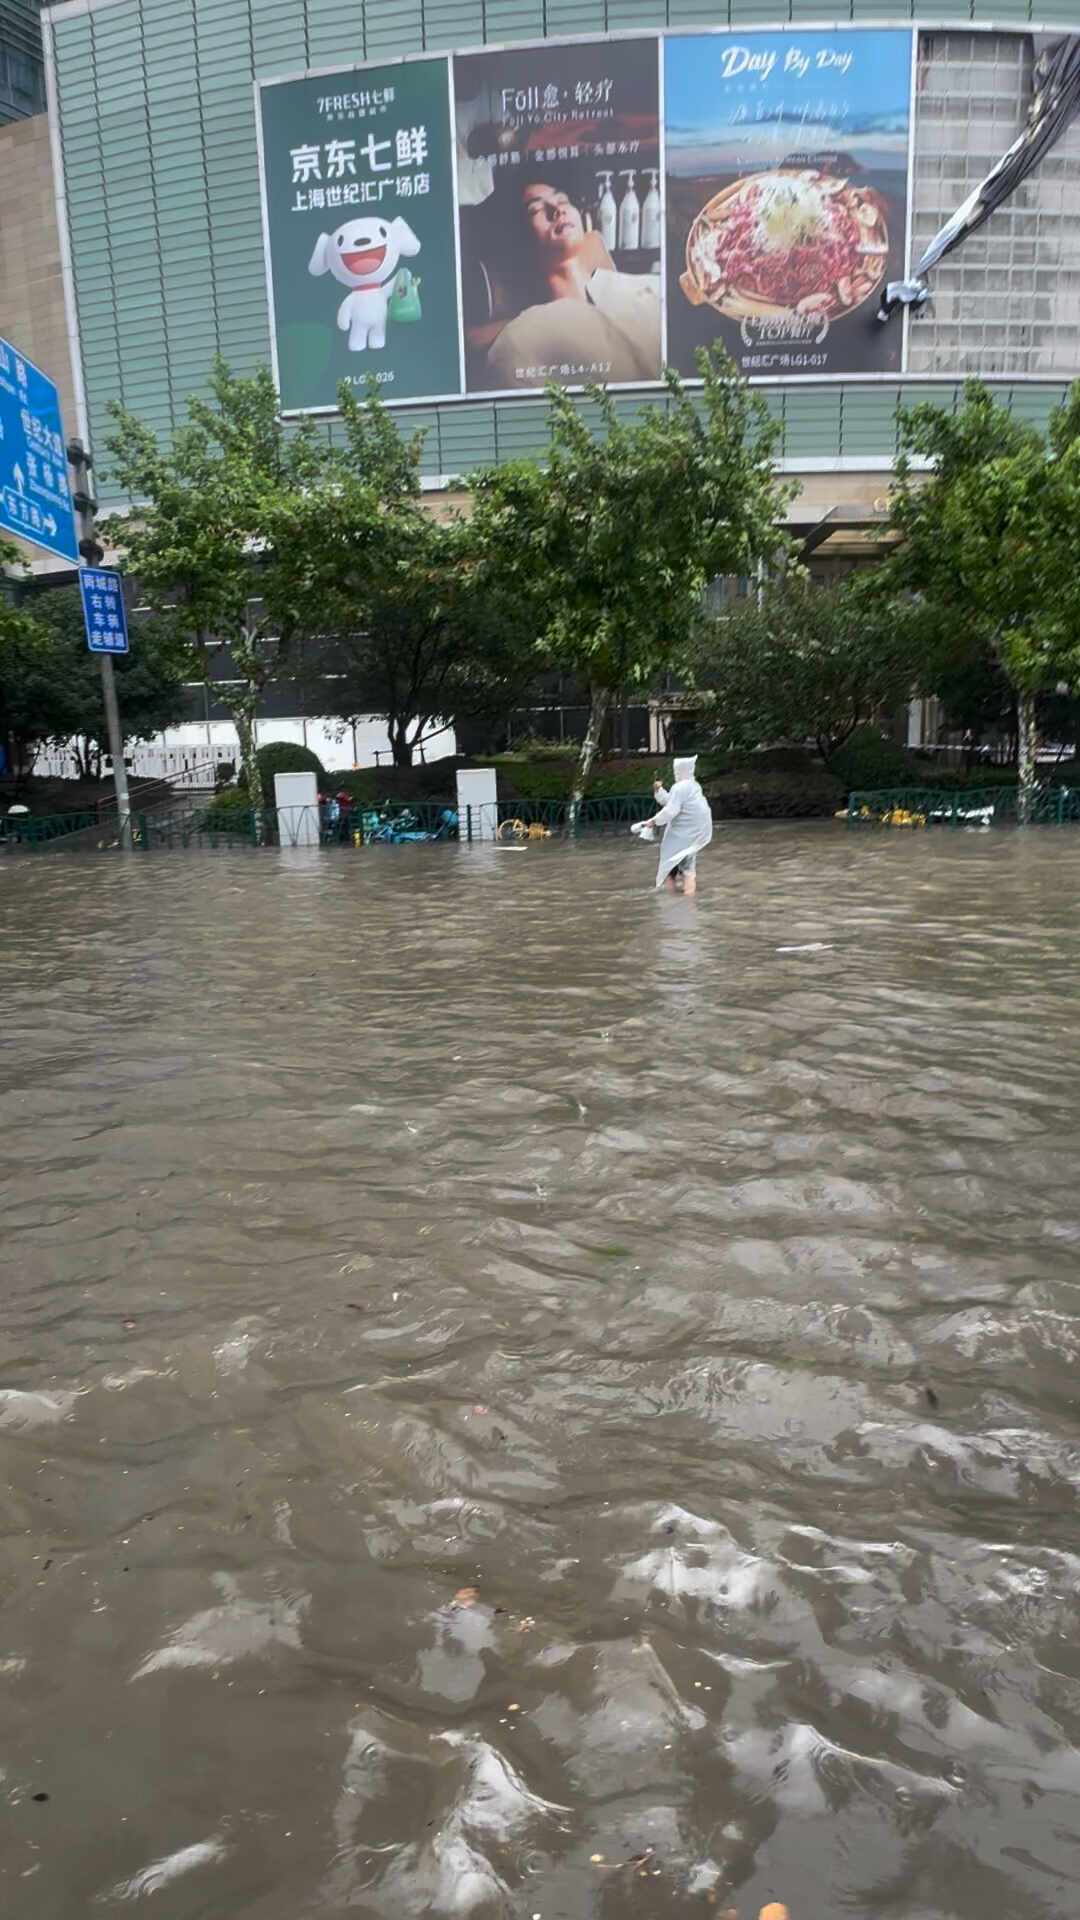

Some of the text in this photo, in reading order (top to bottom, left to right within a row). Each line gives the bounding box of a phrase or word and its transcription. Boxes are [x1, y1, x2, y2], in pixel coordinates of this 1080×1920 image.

[721, 46, 854, 81] Day By Day
[289, 125, 429, 184] 京东七鲜
[291, 172, 431, 212] 上海世纪汇广场店
